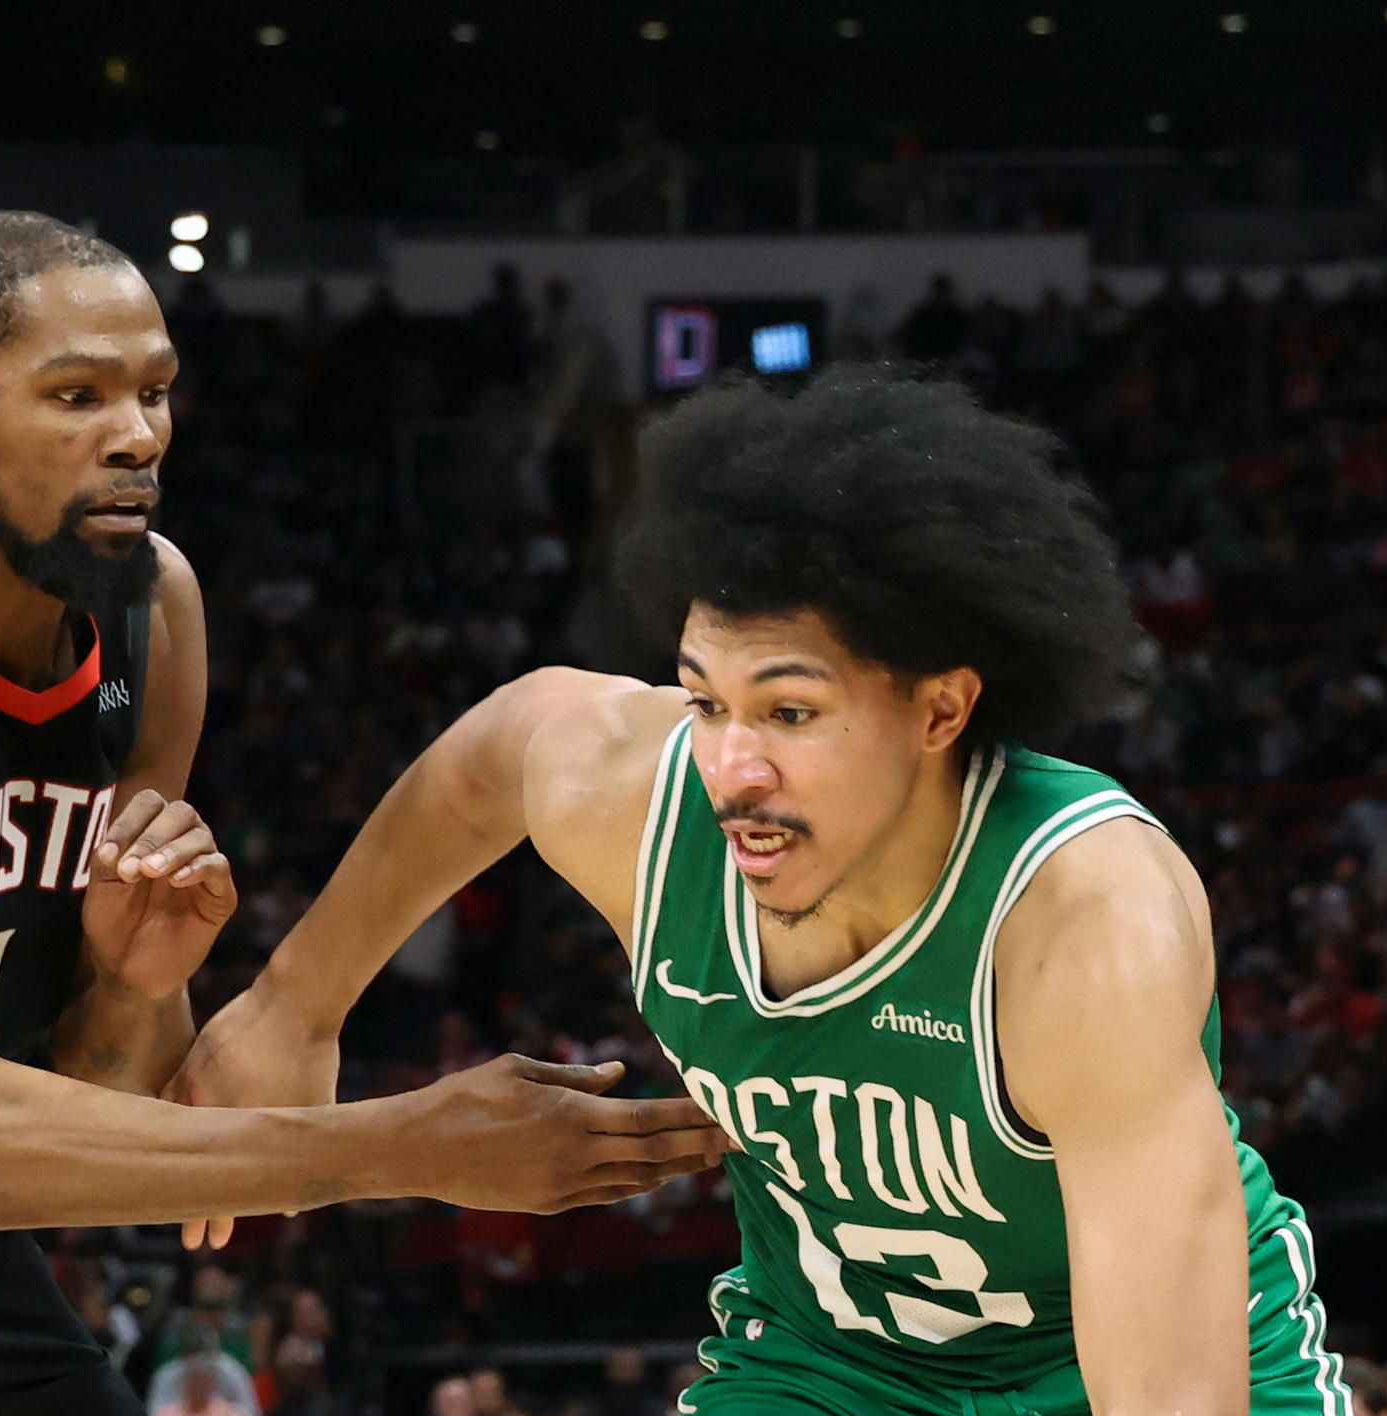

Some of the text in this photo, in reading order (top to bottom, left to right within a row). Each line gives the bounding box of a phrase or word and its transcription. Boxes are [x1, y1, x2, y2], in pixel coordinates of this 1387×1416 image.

[871, 1003, 966, 1043] Amica
[674, 1058, 1007, 1223] OSTON
[765, 1181, 1035, 1344] 13
